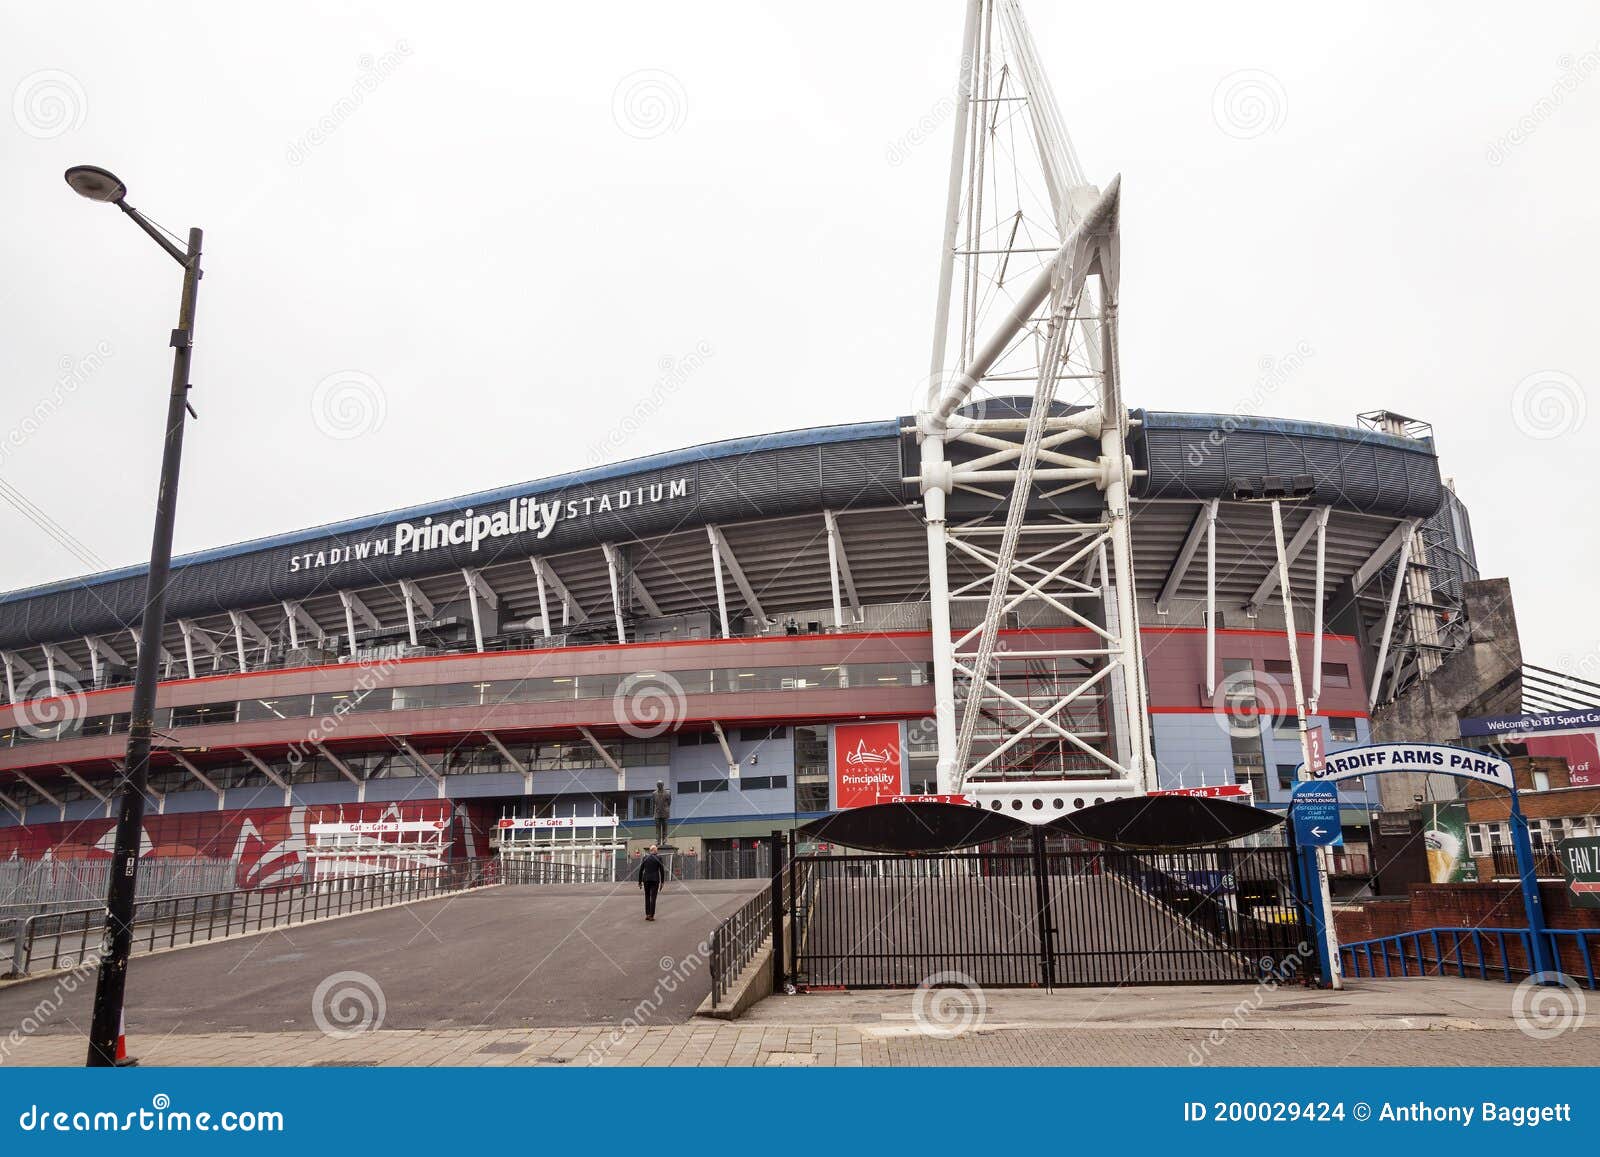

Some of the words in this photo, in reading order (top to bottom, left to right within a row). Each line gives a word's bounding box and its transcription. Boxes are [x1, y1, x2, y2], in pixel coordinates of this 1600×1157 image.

[290, 538, 389, 572] STADIWM
[394, 497, 561, 556] Principality
[567, 478, 687, 520] STADIUM
[1487, 720, 1529, 730] Welcome
[1531, 719, 1541, 727] to
[1543, 717, 1555, 726] BT
[1557, 715, 1586, 725] Sport
[1587, 713, 1600, 722] Ca
[1312, 741, 1319, 758] 2
[1392, 750, 1444, 765] ARMS
[1450, 755, 1500, 777] PARK
[1577, 762, 1589, 771] of
[842, 773, 894, 785] Principality
[945, 796, 951, 804] 2
[1189, 789, 1208, 798] Gate
[1215, 788, 1221, 796] 2
[372, 823, 388, 831] Gate
[394, 823, 399, 831] 3
[1568, 847, 1591, 873] FAN
